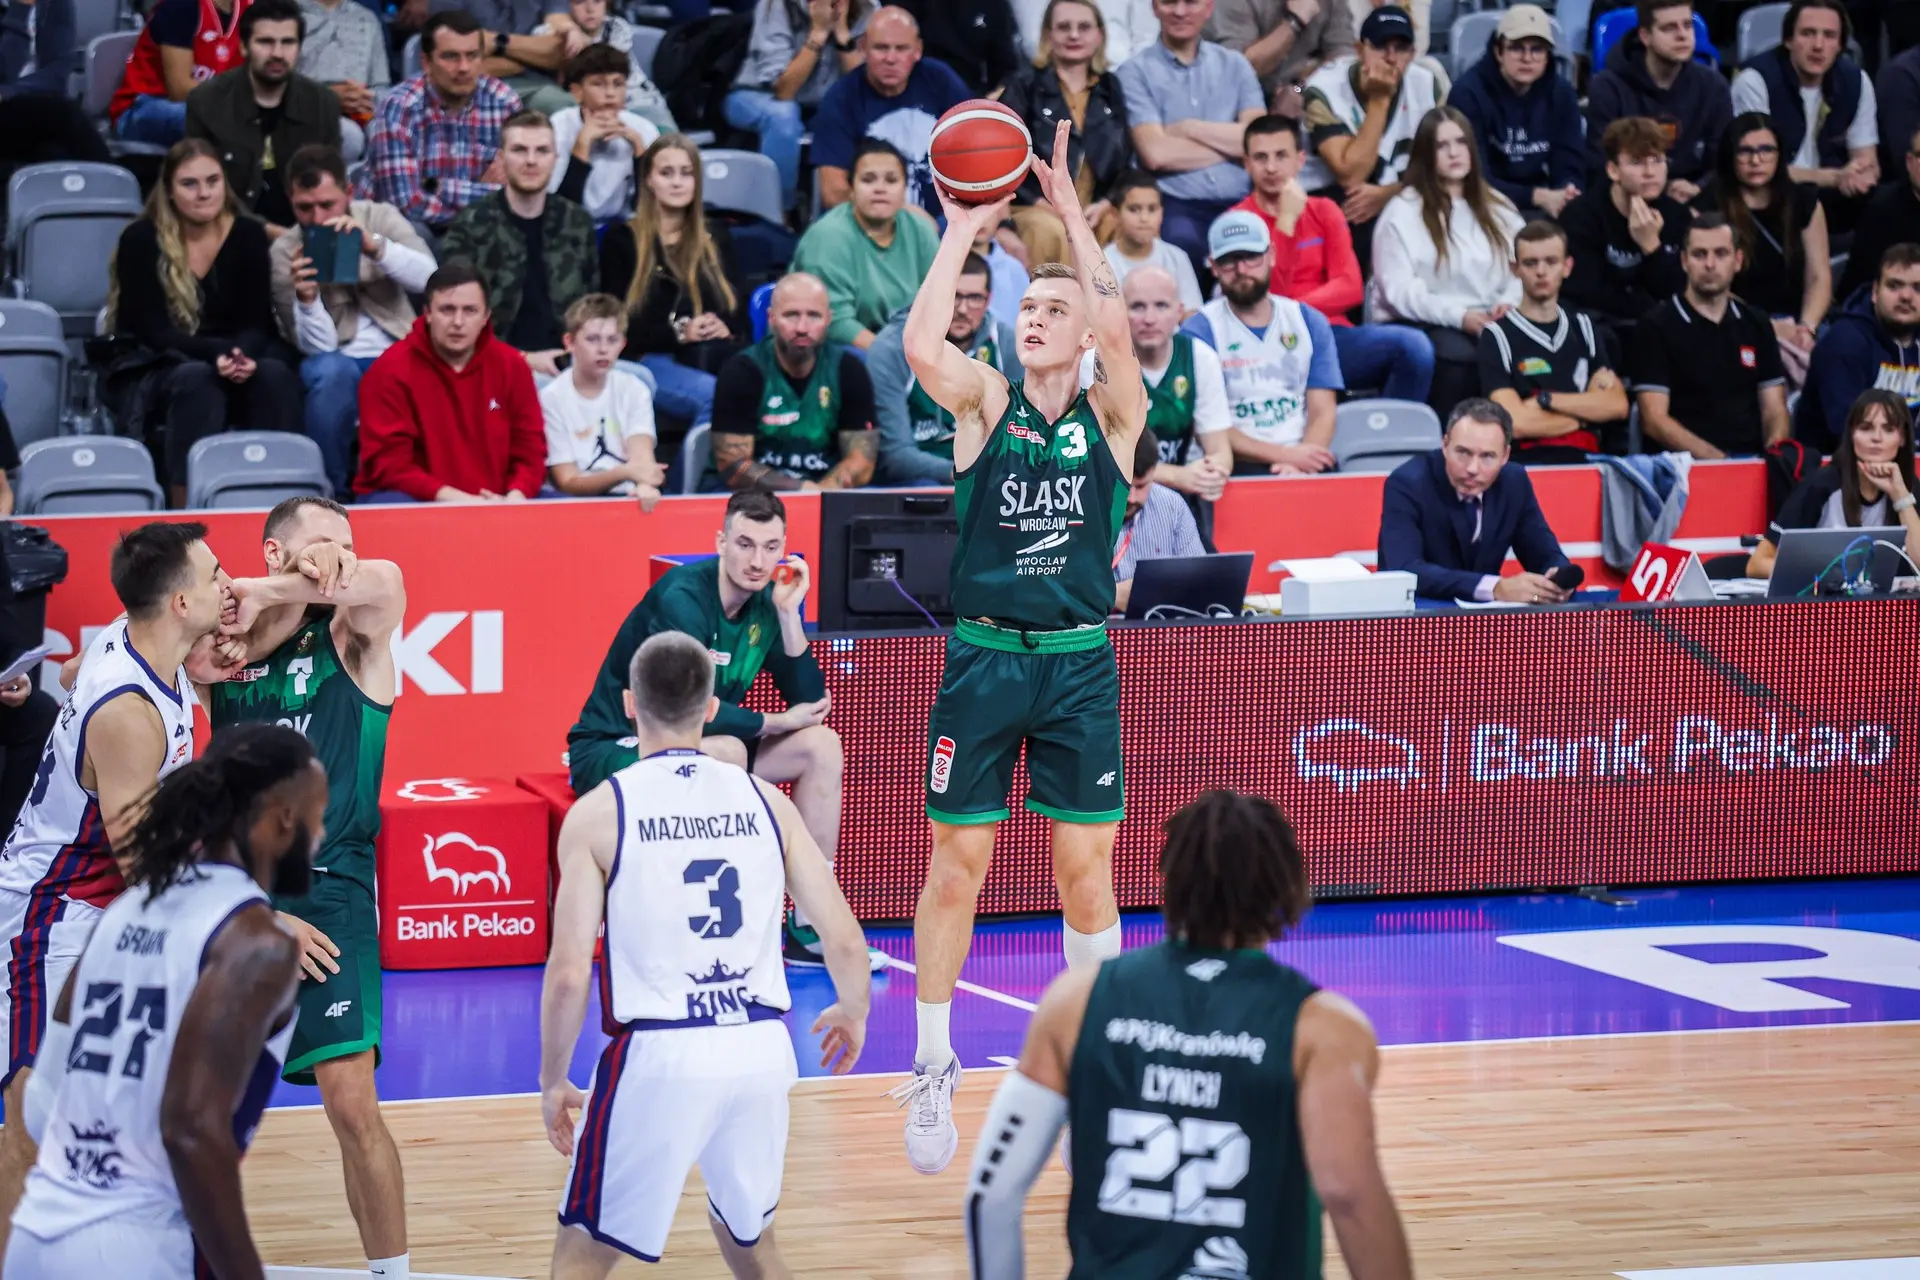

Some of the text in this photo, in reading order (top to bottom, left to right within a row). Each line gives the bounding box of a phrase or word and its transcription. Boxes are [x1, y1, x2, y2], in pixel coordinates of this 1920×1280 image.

[1058, 422, 1087, 458] 3
[1000, 473, 1086, 516] ŚLĄSK
[1020, 517, 1067, 531] WROCŁAW
[1016, 556, 1067, 566] WROCLAW
[1016, 566, 1063, 575] AIRPORT
[1631, 549, 1668, 602] 5
[1470, 712, 1891, 781] Bank Pekao
[638, 812, 760, 842] MAZURCZAK
[683, 859, 743, 939] 3
[397, 911, 535, 941] Bank Pekao
[1140, 1063, 1222, 1109] LYNCH
[1097, 1108, 1250, 1228] 22
